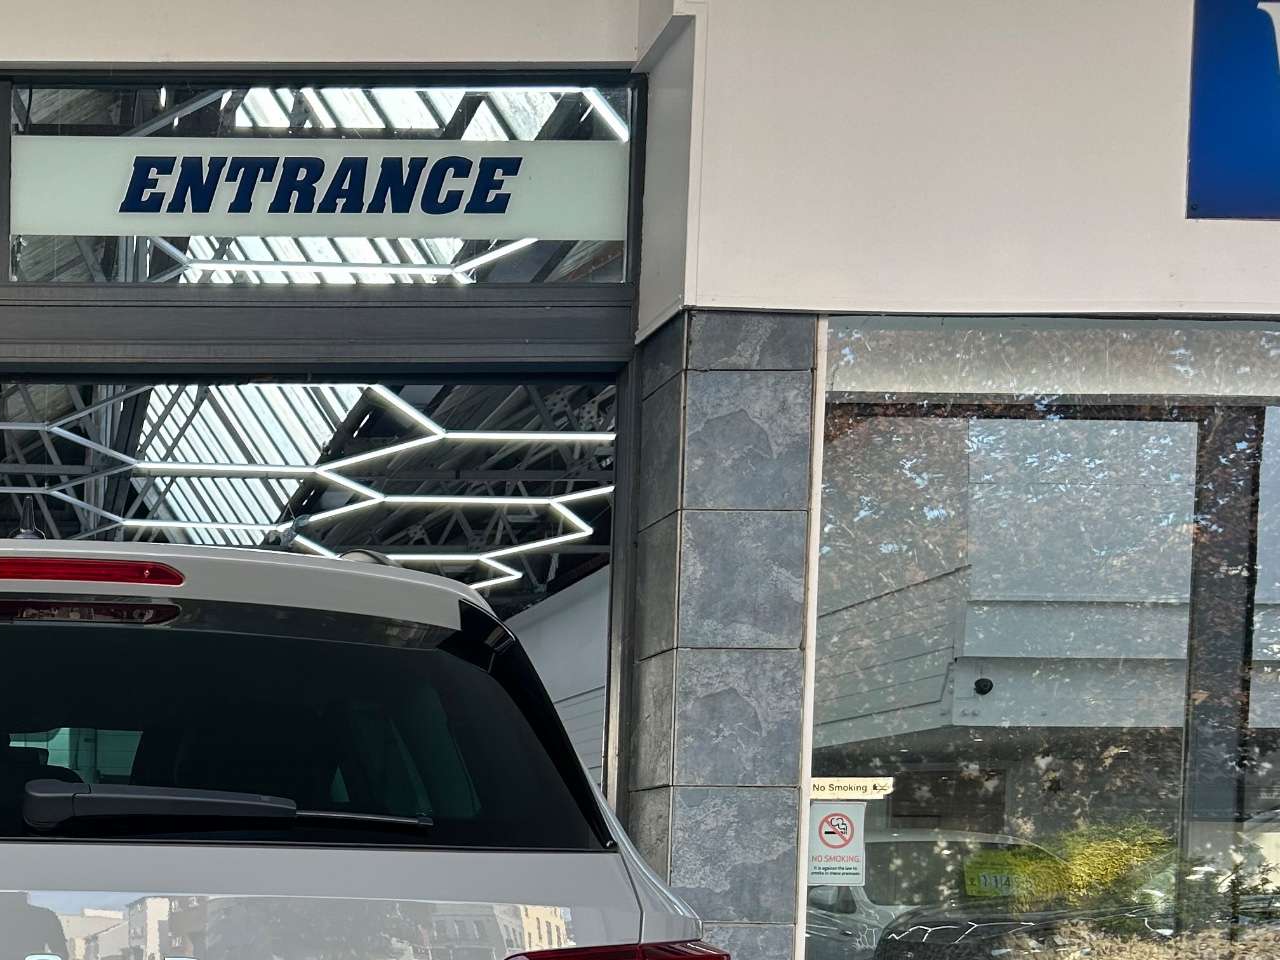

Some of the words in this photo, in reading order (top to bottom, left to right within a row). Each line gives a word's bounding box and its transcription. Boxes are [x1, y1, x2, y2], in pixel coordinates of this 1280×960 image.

[118, 155, 523, 215] ENTRANCE
[812, 783, 826, 792] No
[828, 783, 868, 793] Smoking
[811, 855, 823, 863] NO
[823, 855, 861, 863] SMOKING
